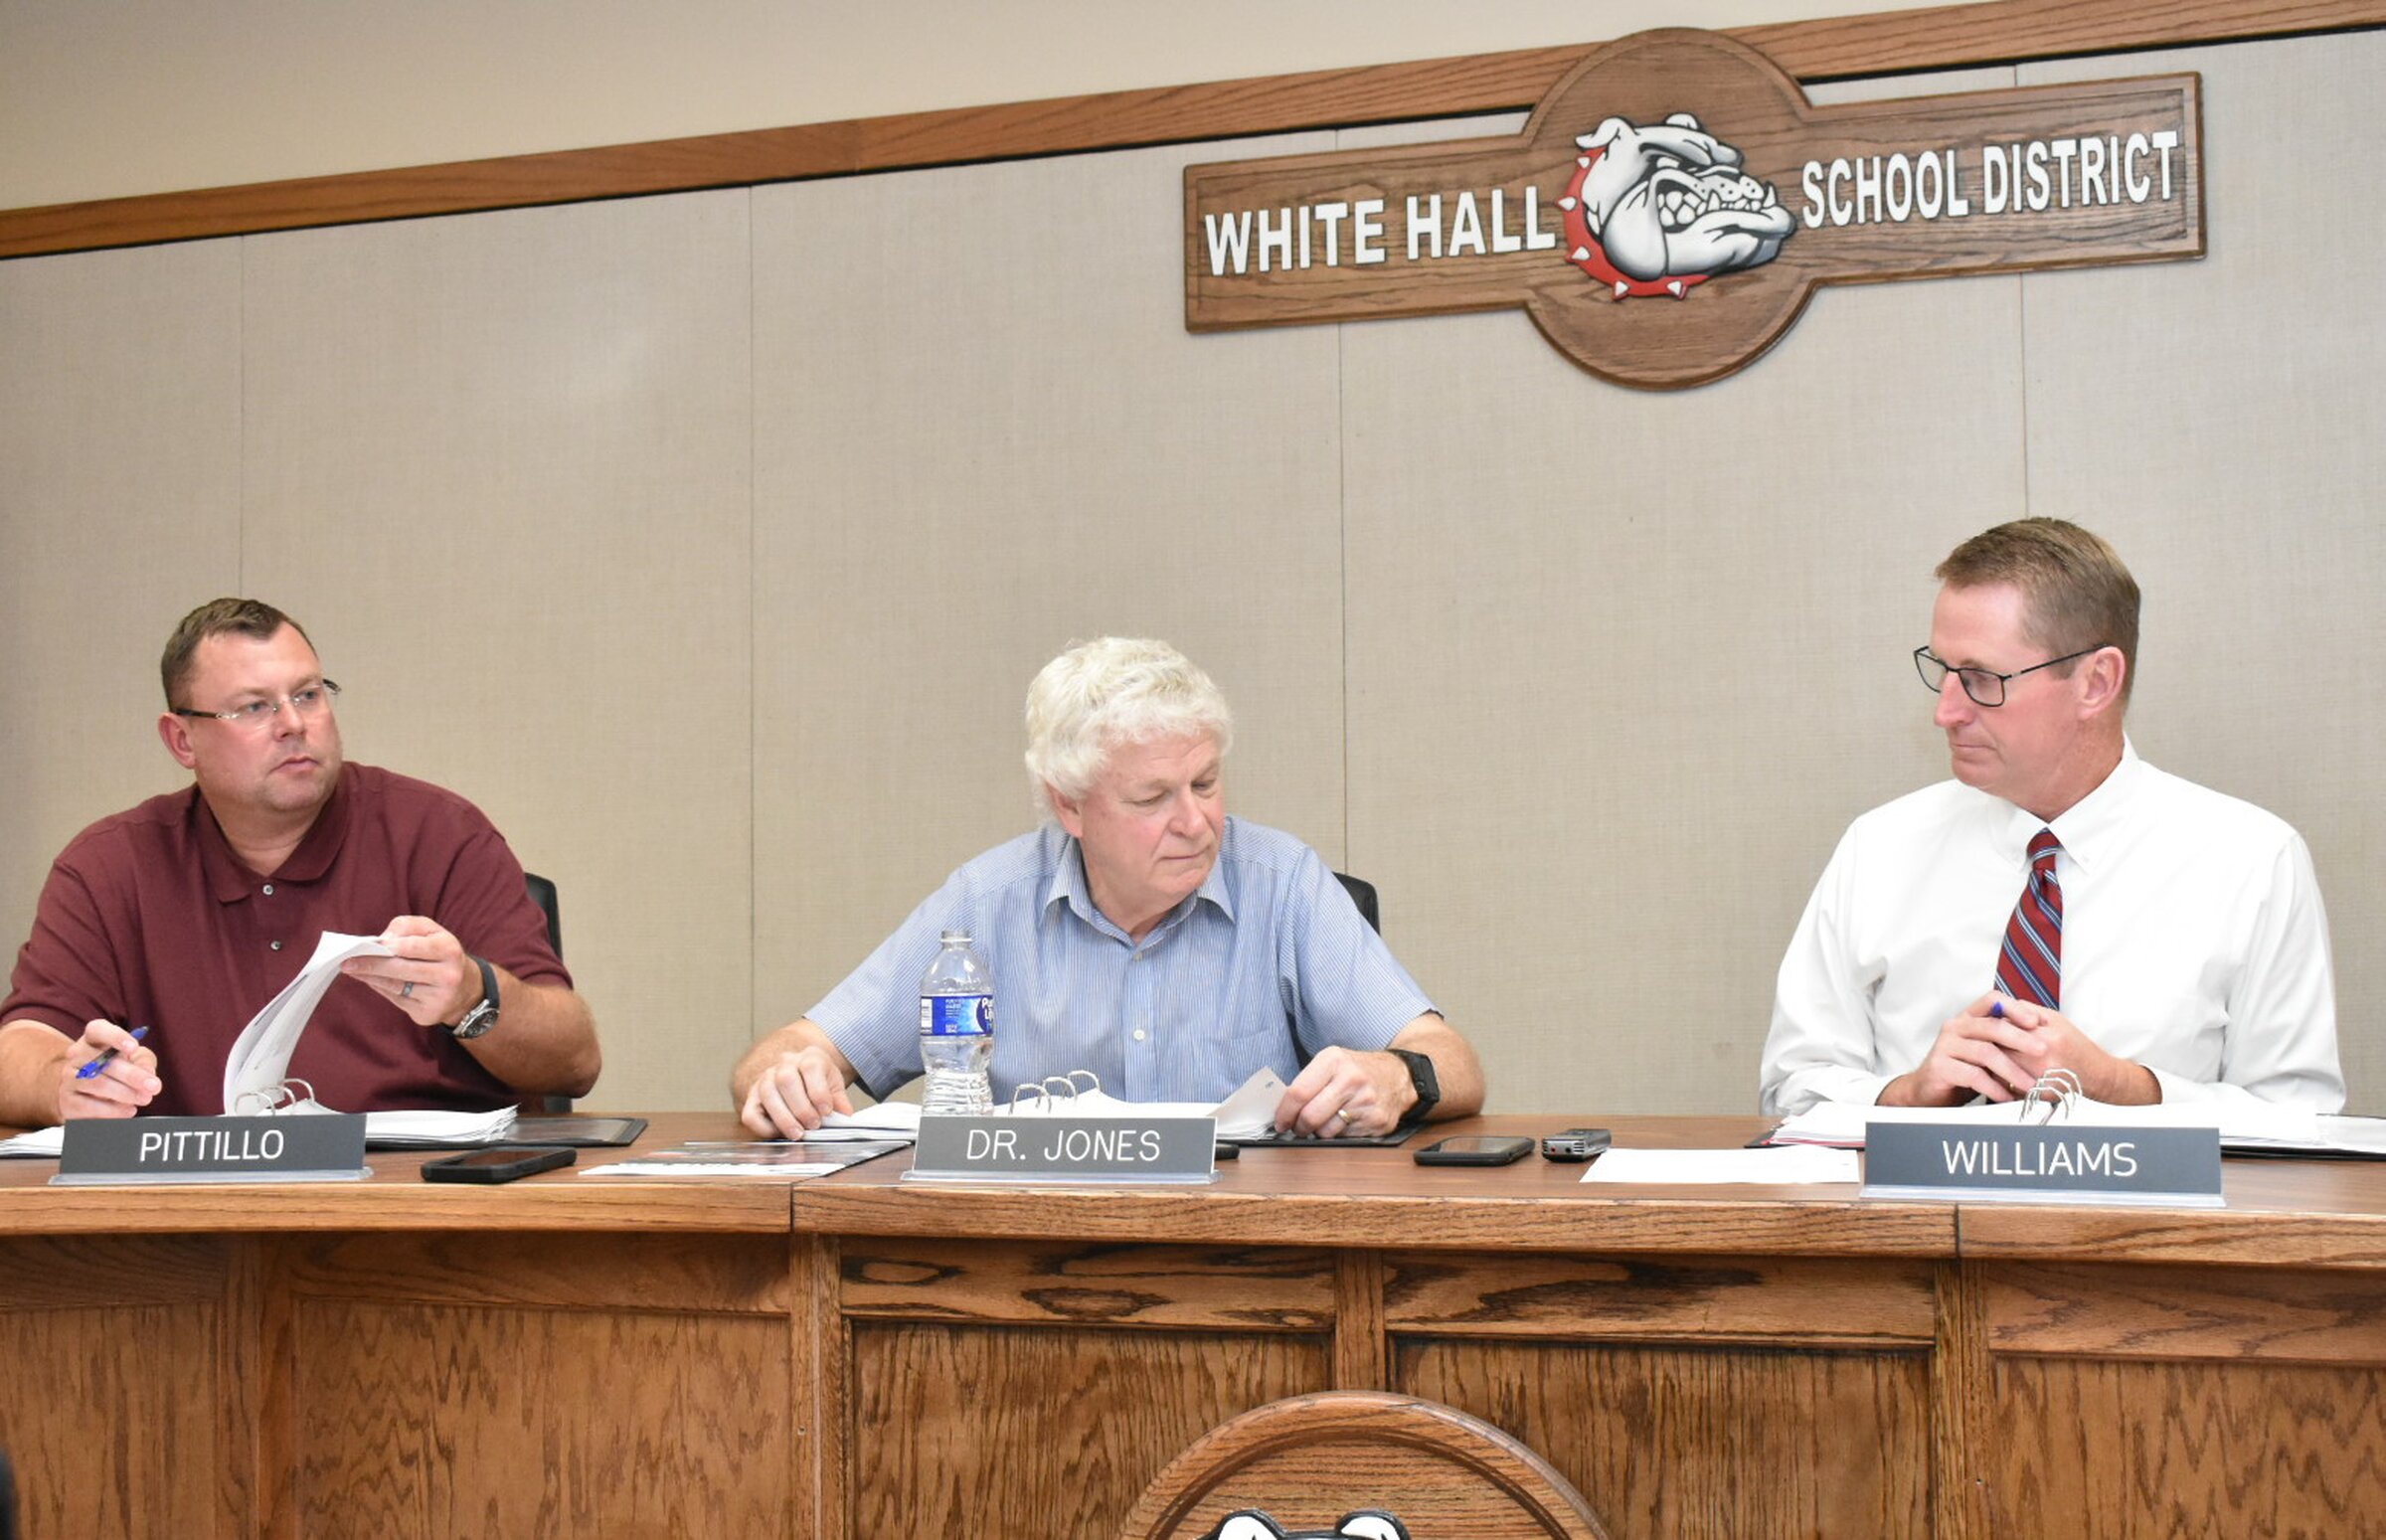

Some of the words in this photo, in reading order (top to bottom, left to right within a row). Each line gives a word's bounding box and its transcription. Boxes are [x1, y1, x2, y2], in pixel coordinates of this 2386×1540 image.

[1205, 199, 1386, 276] WHITE
[1406, 186, 1557, 260] HALL
[1801, 150, 1970, 229] SCHOOL
[1981, 131, 2179, 214] DISTRICT
[139, 1129, 284, 1162] PITTILLO
[965, 1128, 1027, 1162] DR.
[1043, 1128, 1161, 1162] JONES
[1942, 1139, 2138, 1178] WILLIAMS
